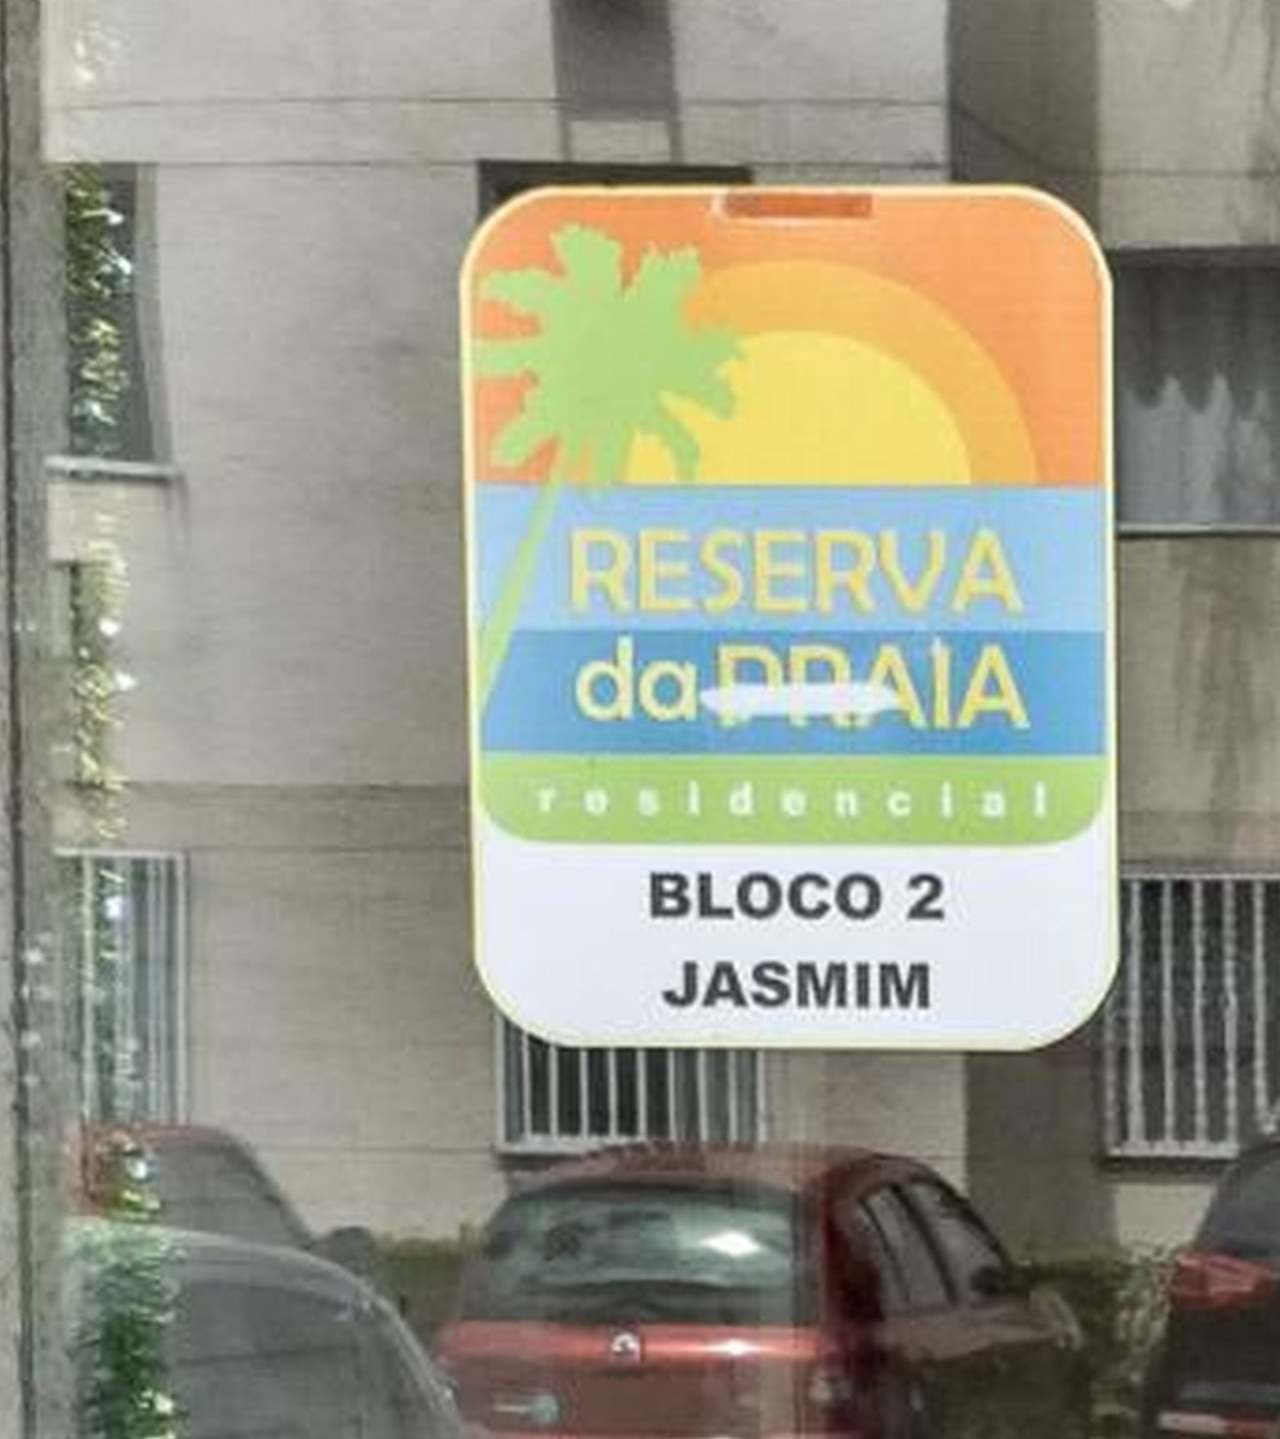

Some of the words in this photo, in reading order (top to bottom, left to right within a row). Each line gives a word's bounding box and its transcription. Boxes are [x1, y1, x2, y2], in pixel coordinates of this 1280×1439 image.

[568, 527, 1024, 615] RESERVA
[575, 635, 699, 721] da
[716, 641, 1031, 730] PRAIA
[538, 779, 1050, 818] residencial
[649, 872, 882, 920] BLOCO
[907, 873, 945, 919] 2
[662, 961, 931, 1009] JASMIM
